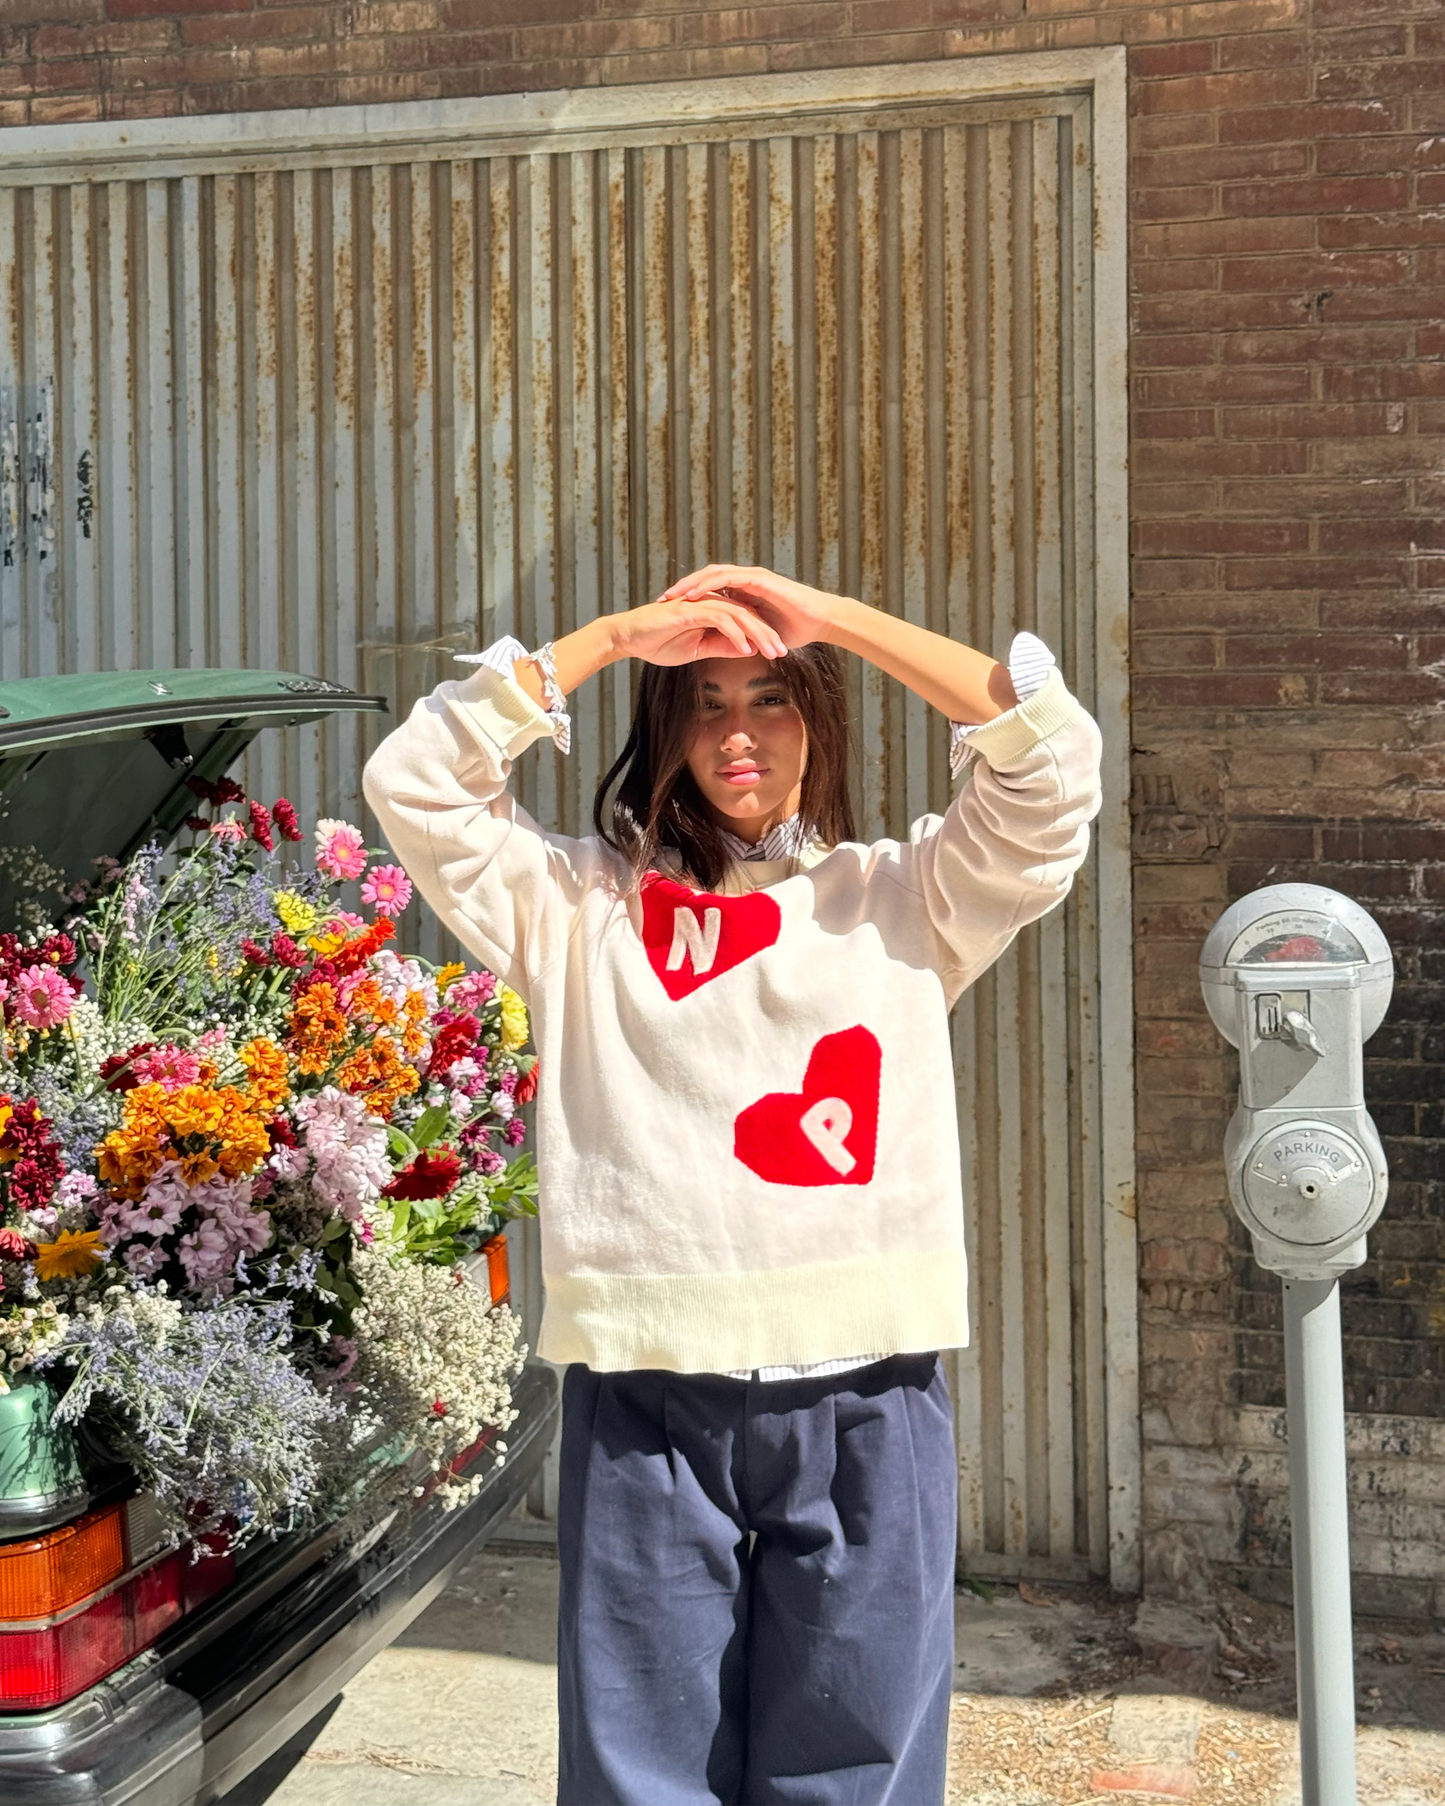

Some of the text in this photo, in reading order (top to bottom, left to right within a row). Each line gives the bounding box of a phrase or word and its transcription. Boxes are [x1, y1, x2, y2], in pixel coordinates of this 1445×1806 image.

[665, 906, 722, 977] N
[799, 1096, 857, 1178] P
[1273, 1142, 1341, 1163] PARKING
